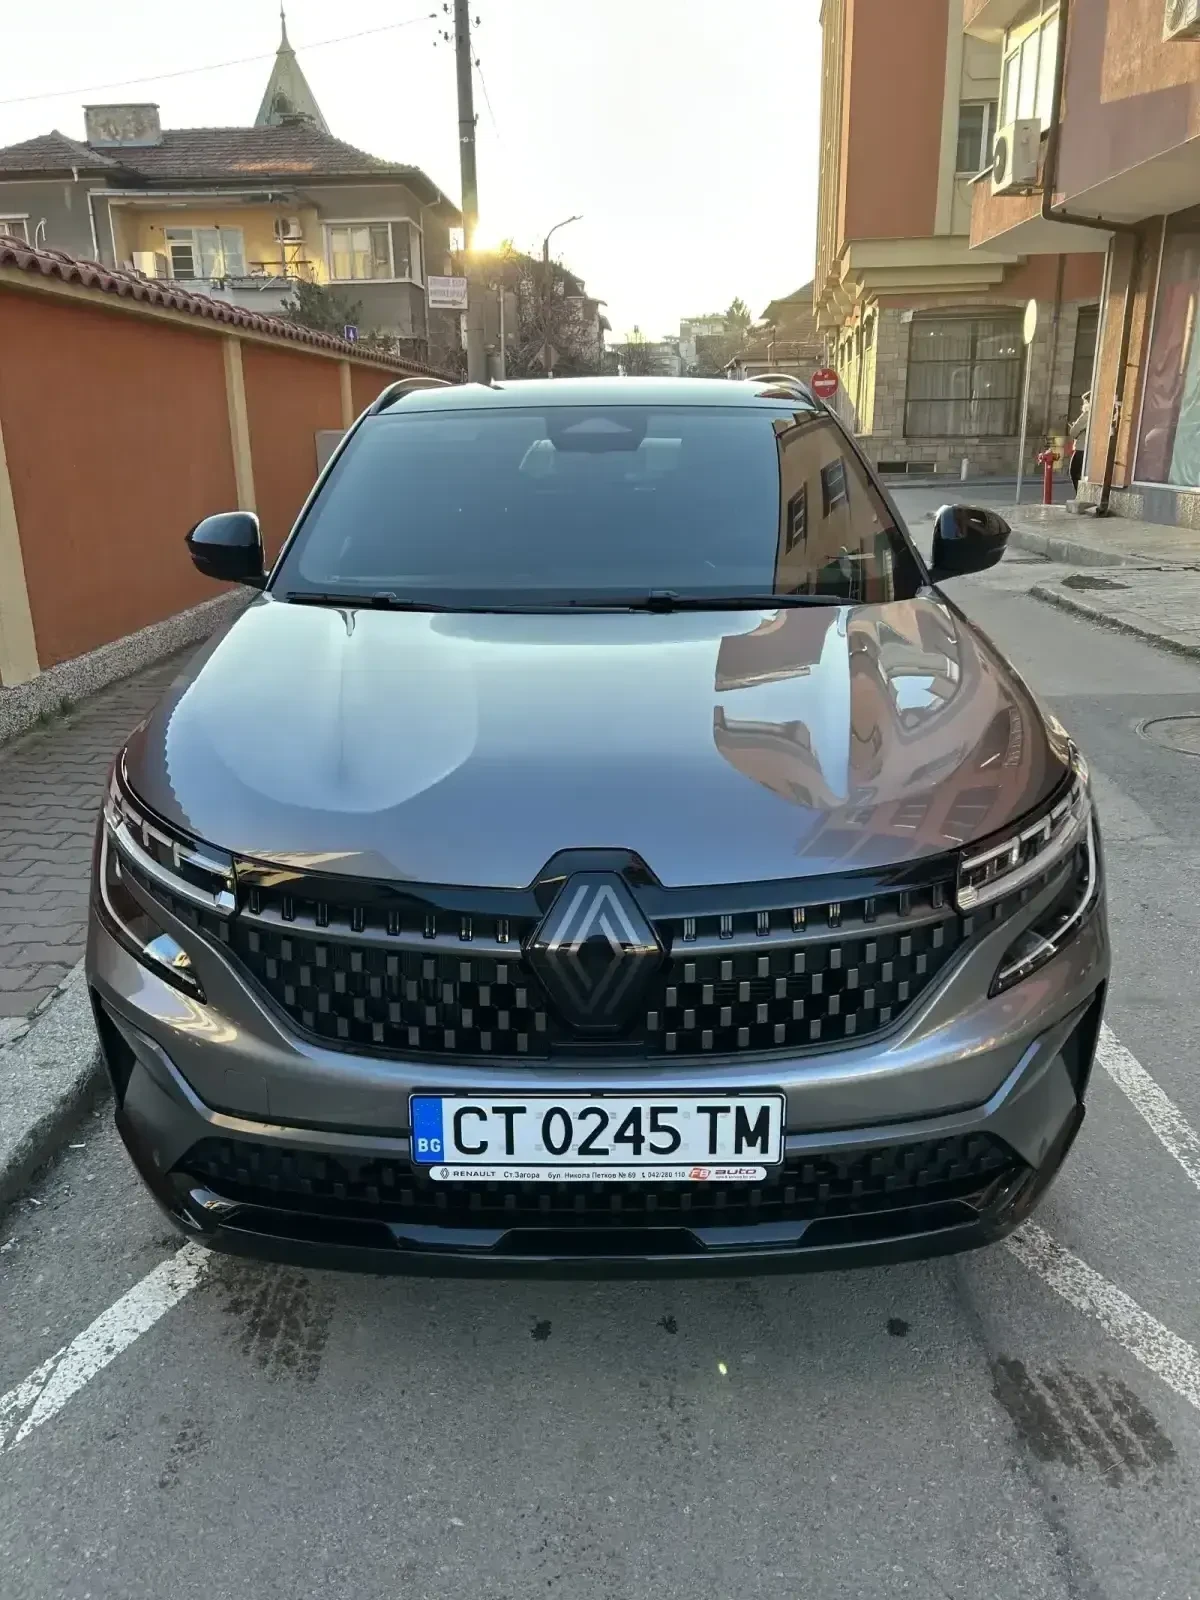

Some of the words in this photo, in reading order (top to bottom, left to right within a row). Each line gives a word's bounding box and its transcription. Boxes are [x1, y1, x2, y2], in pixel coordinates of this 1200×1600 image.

[417, 1137, 441, 1153] BG
[453, 1107, 527, 1155] CT
[541, 1107, 681, 1155] 0245
[697, 1106, 770, 1155] TM
